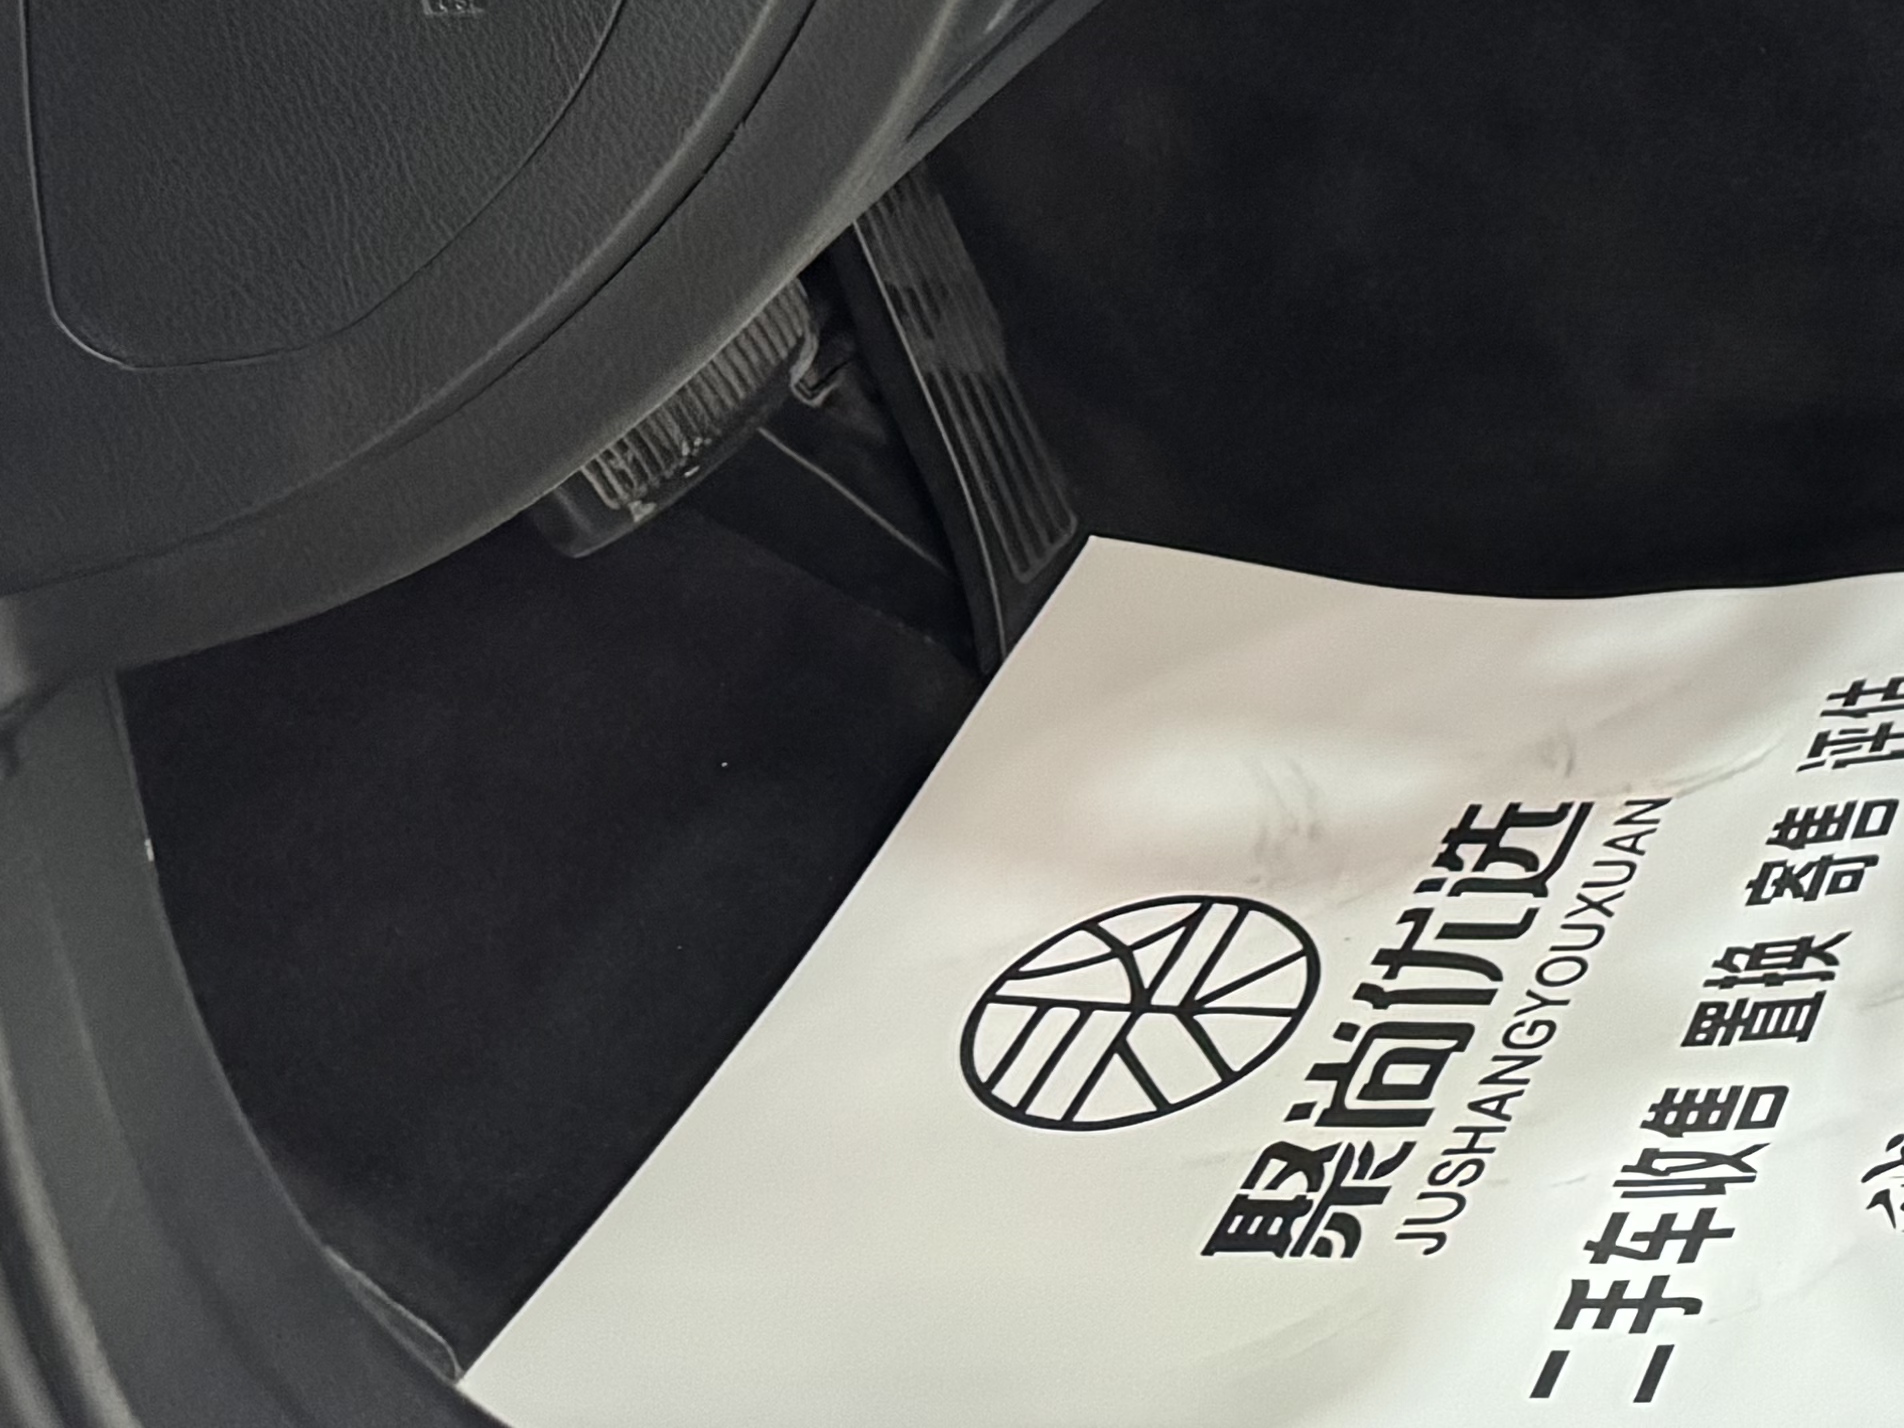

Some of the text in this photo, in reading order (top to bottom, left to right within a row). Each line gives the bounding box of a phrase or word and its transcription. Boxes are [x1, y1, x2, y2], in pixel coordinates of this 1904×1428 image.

[1680, 931, 1853, 1048] 置换
[1745, 798, 1899, 907] 寄售
[1200, 801, 1595, 1260] 聚尚优选
[1395, 797, 1673, 1256] JUSHANGYOUXUAN
[1529, 1084, 1790, 1404] 二手车收售
